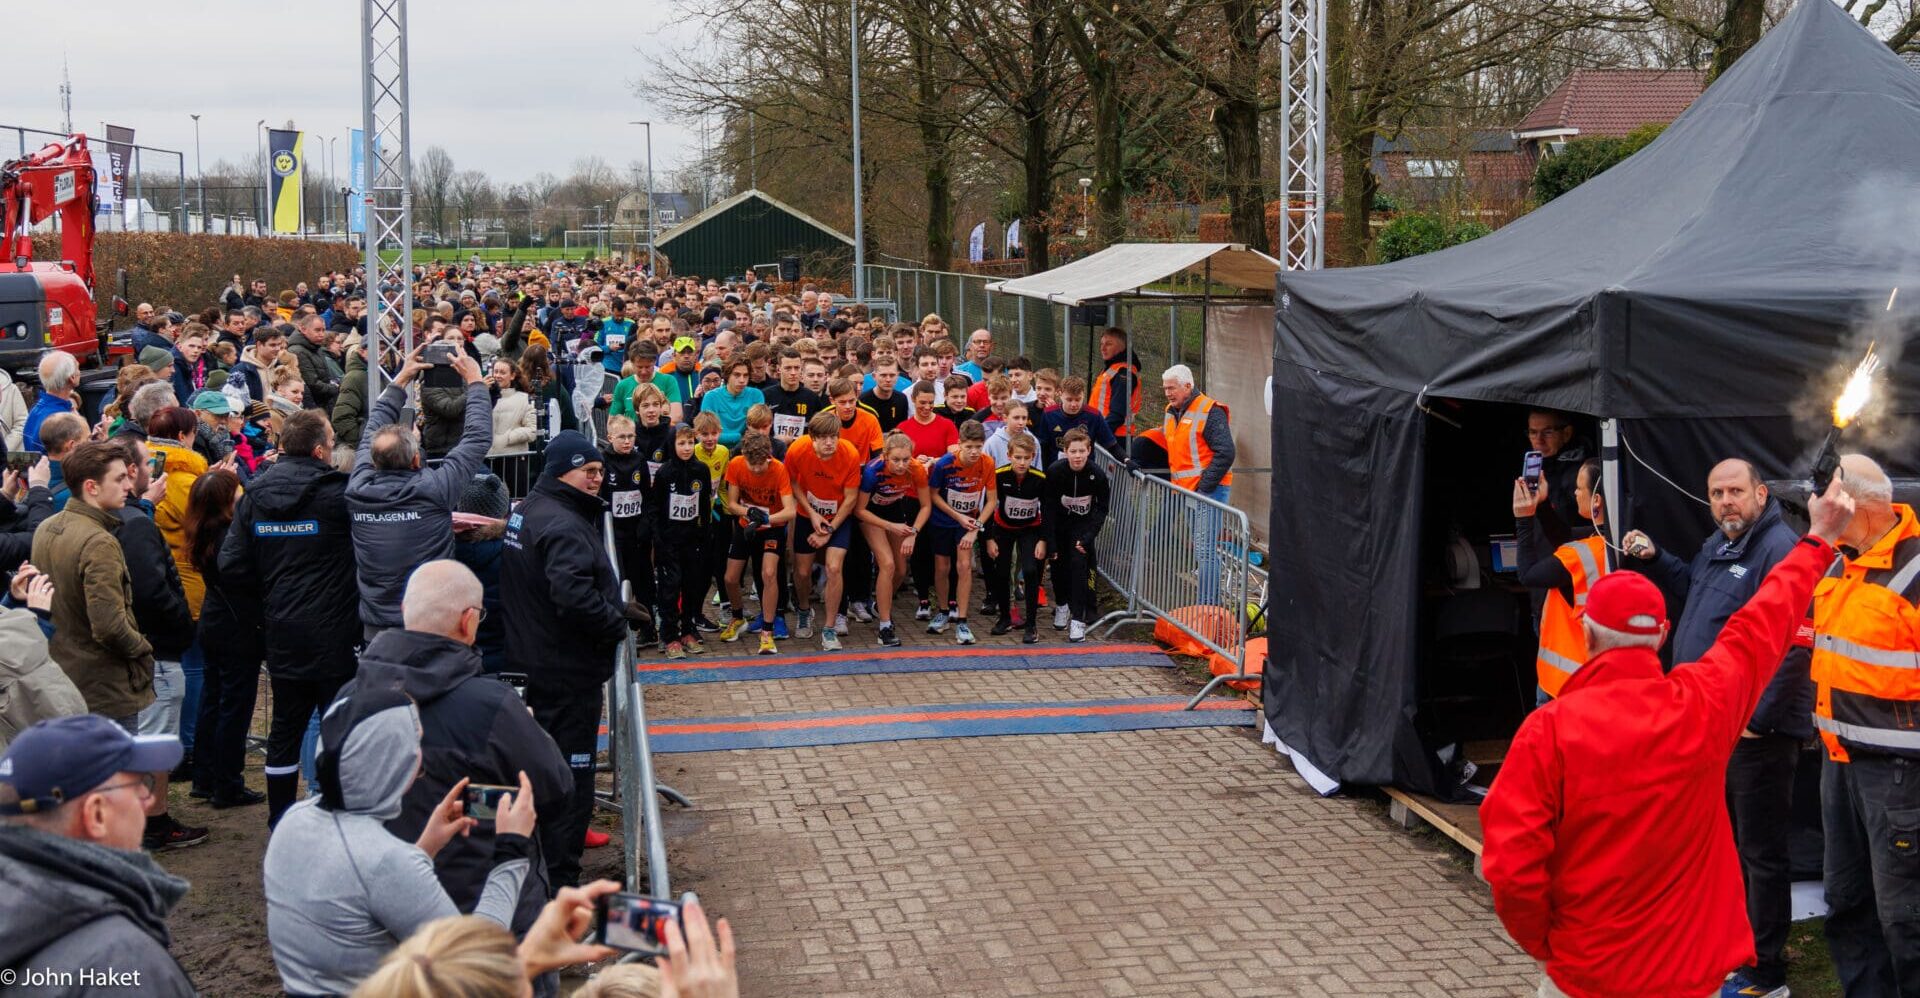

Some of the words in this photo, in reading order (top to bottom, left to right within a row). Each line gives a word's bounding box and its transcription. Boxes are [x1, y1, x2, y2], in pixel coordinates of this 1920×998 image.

[796, 403, 807, 415] 18
[951, 499, 976, 511] 1639
[353, 511, 422, 522] UITSLAGEN.NL
